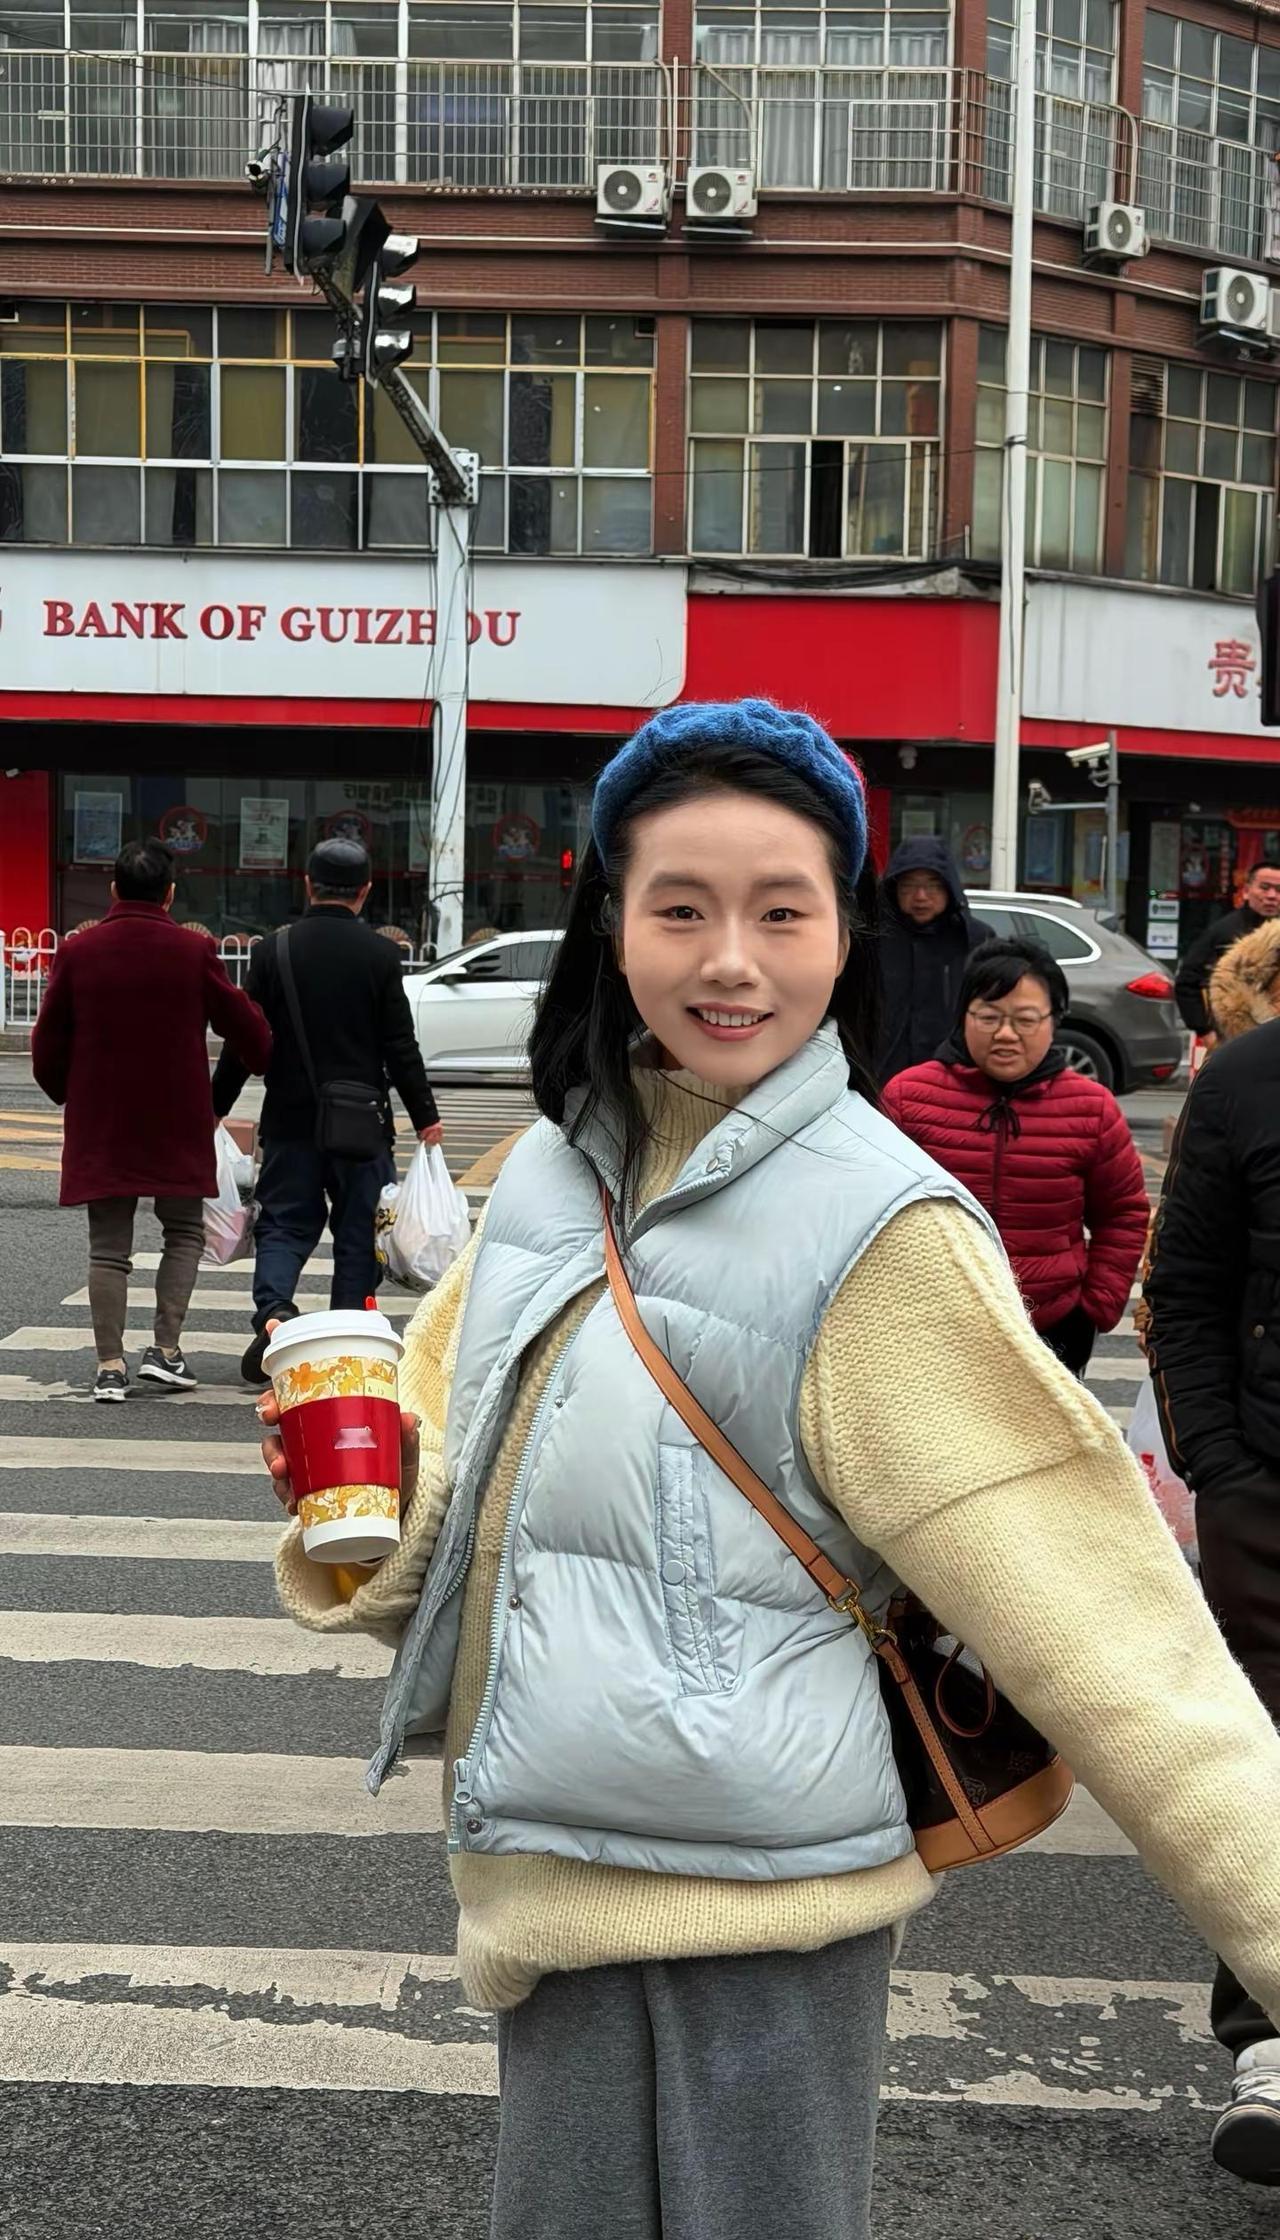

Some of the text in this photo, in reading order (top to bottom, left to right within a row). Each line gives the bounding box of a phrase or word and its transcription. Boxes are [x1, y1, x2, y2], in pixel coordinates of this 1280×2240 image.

[43, 600, 187, 639] BANK
[199, 604, 266, 640] OF
[1208, 638, 1263, 699] 贵
